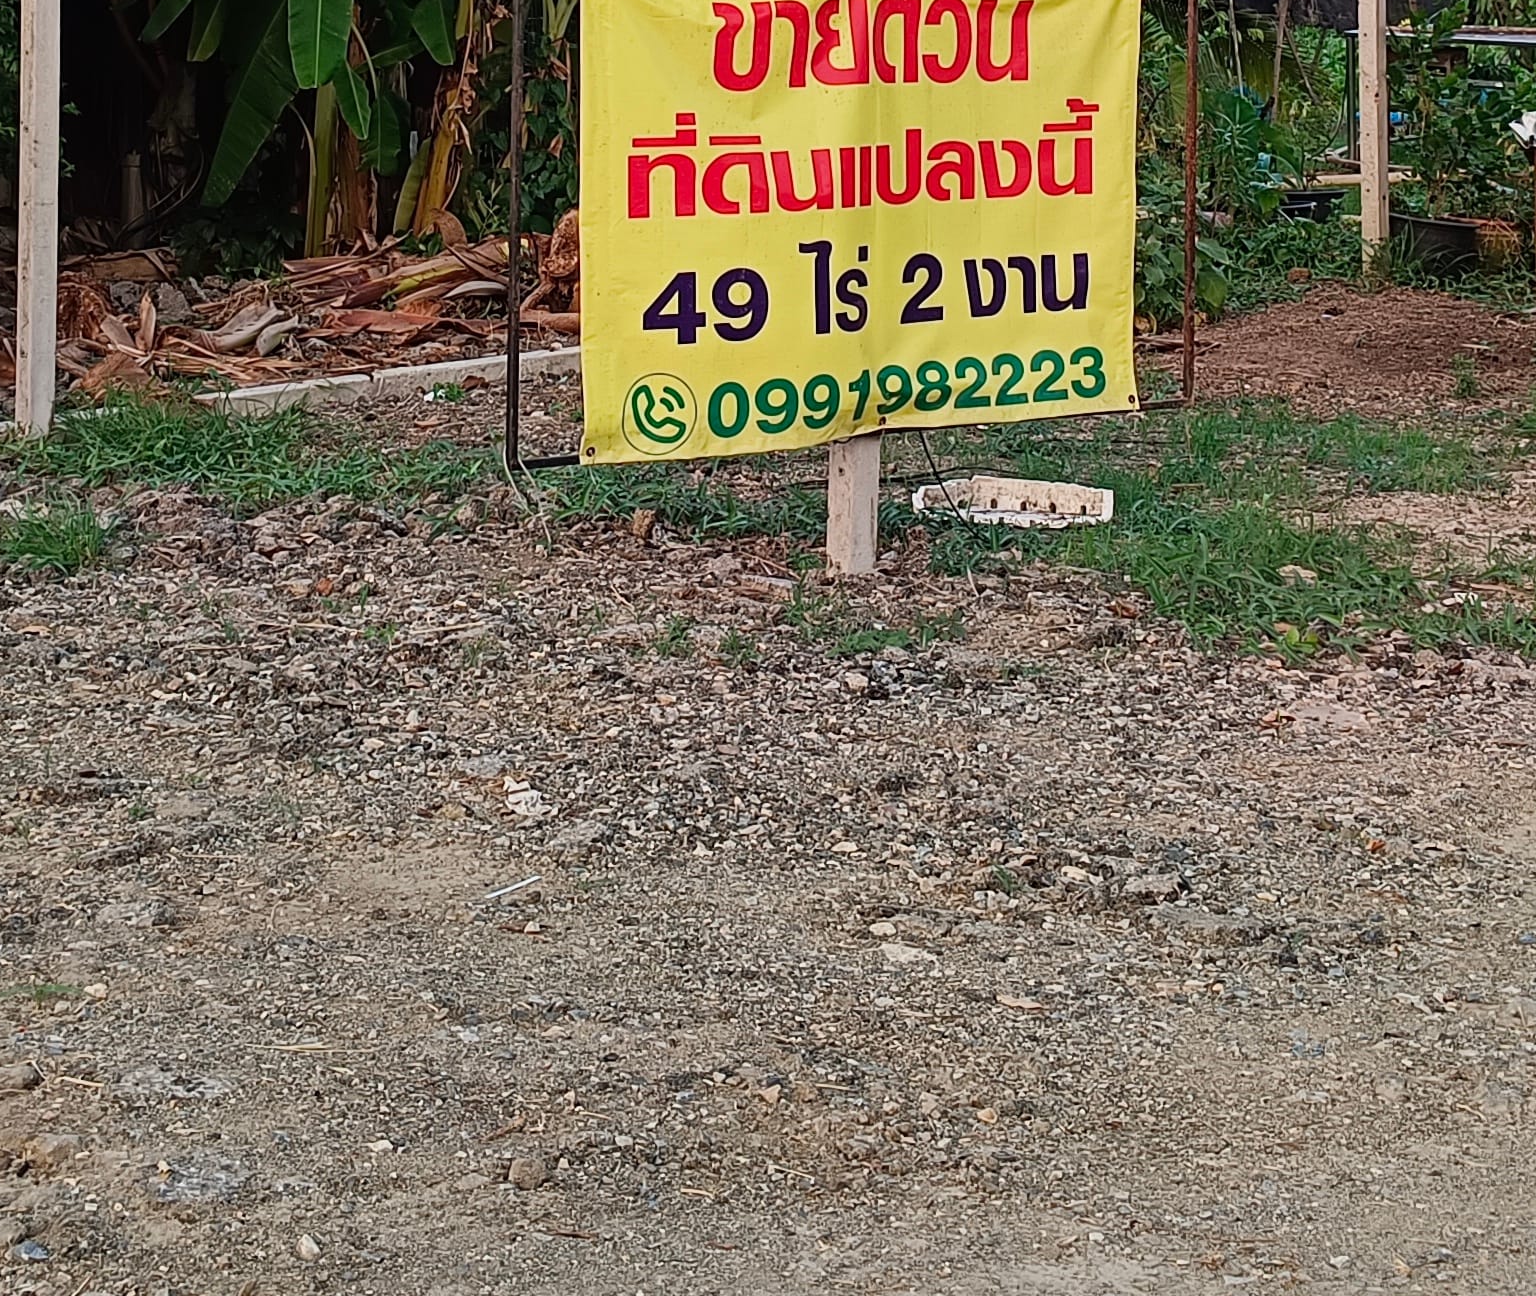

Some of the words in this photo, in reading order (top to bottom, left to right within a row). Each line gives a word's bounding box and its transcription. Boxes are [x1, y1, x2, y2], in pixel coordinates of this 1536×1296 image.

[627, 98, 1100, 220] ที่ดินแปลงนี้
[642, 267, 769, 345] 49
[799, 240, 869, 335] ไร่
[901, 253, 944, 325] 2
[964, 252, 1089, 318] งาน
[709, 346, 1106, 438] 0991982223
